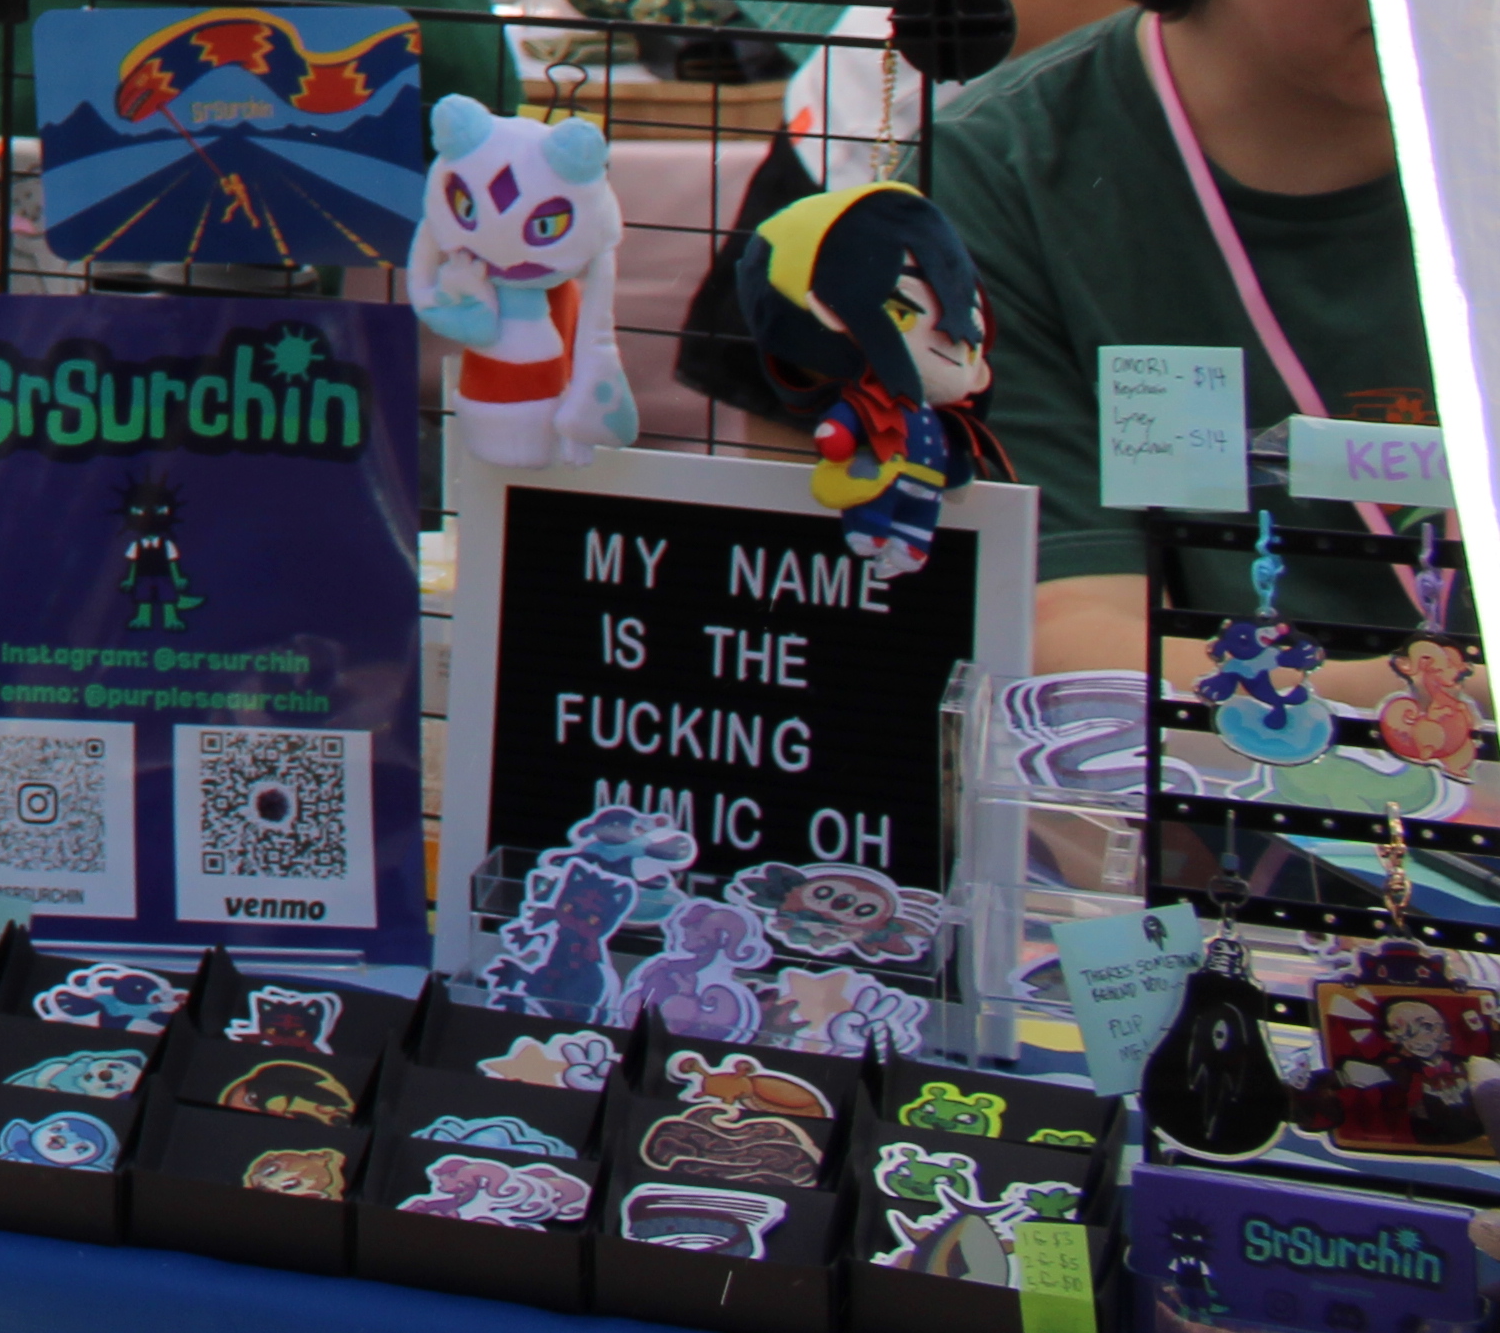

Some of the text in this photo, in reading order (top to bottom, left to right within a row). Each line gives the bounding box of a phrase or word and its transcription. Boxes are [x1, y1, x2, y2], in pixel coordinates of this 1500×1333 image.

[585, 528, 890, 613] MY NAME
[153, 647, 311, 674] @srsurchin
[602, 613, 809, 688] IS THE
[83, 682, 331, 713] @purpleseaurchin
[556, 691, 812, 773] FUCKING
[809, 808, 891, 869] OH
[224, 897, 327, 921] venmo
[1244, 1219, 1443, 1283] SrSurchin
